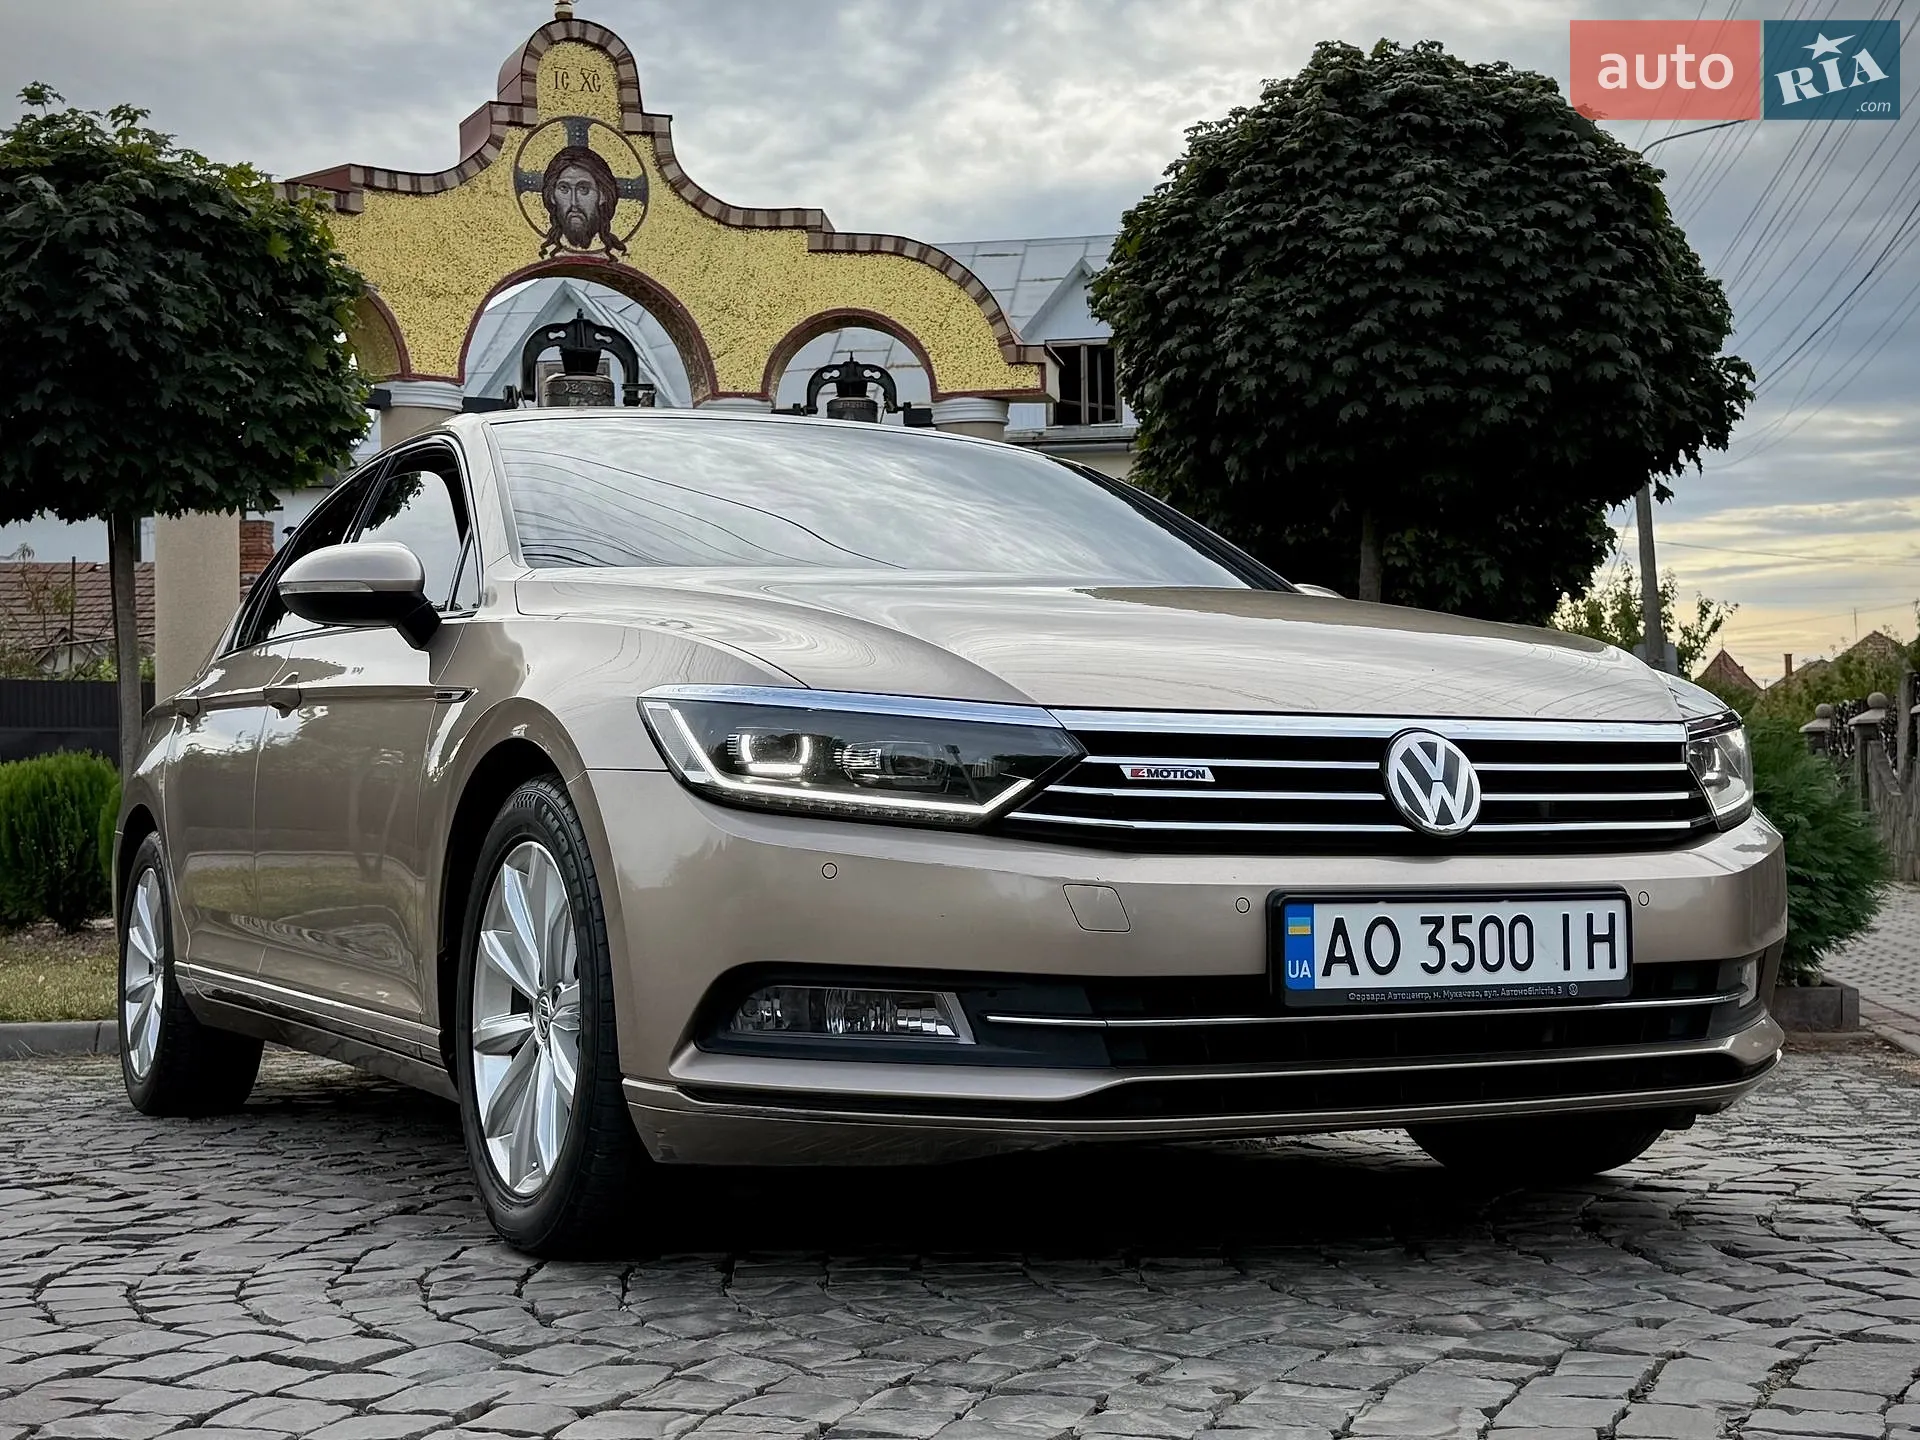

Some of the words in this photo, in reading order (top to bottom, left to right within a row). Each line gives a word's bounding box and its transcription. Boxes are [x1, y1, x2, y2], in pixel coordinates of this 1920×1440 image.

[1321, 915, 1401, 977] AO
[1419, 913, 1535, 975] 3500
[1287, 958, 1312, 980] UA
